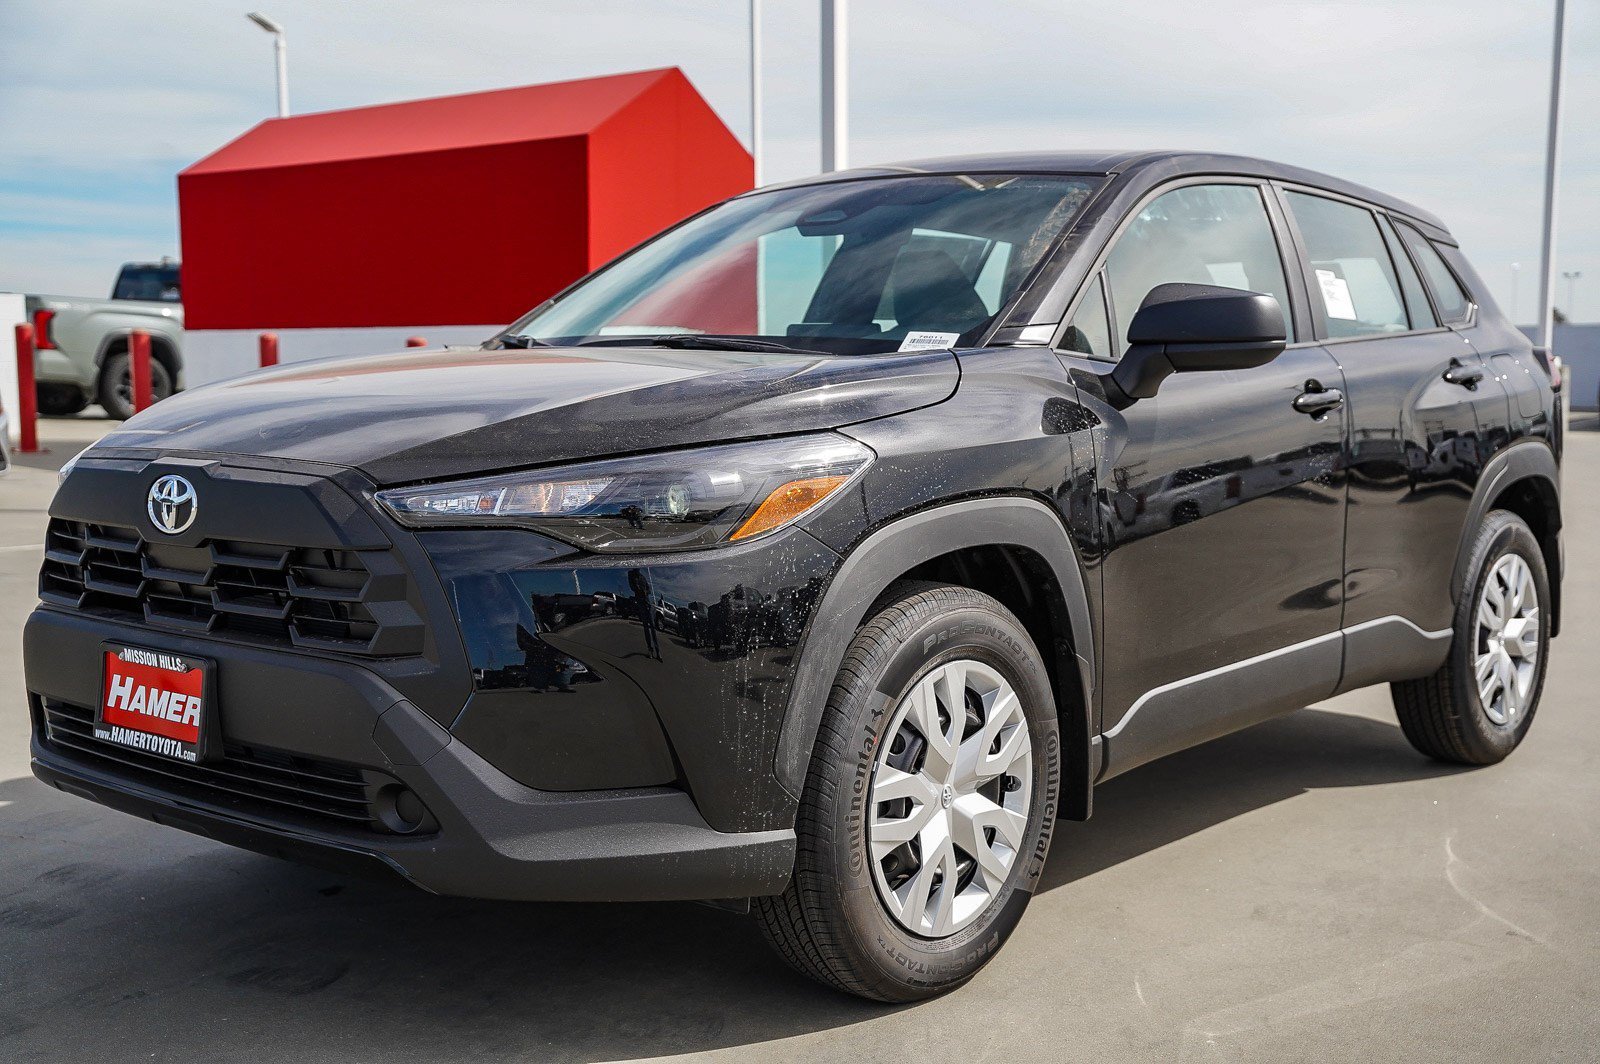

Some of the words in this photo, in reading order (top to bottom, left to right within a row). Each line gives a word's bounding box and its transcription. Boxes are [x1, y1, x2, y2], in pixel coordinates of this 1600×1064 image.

[123, 648, 158, 667] MISSION
[159, 655, 182, 672] HILLS
[107, 674, 202, 727] HAMER
[95, 726, 197, 762] www.HAMERTOYOTA.com
[844, 724, 877, 877] Continental
[1034, 729, 1058, 863] Continental
